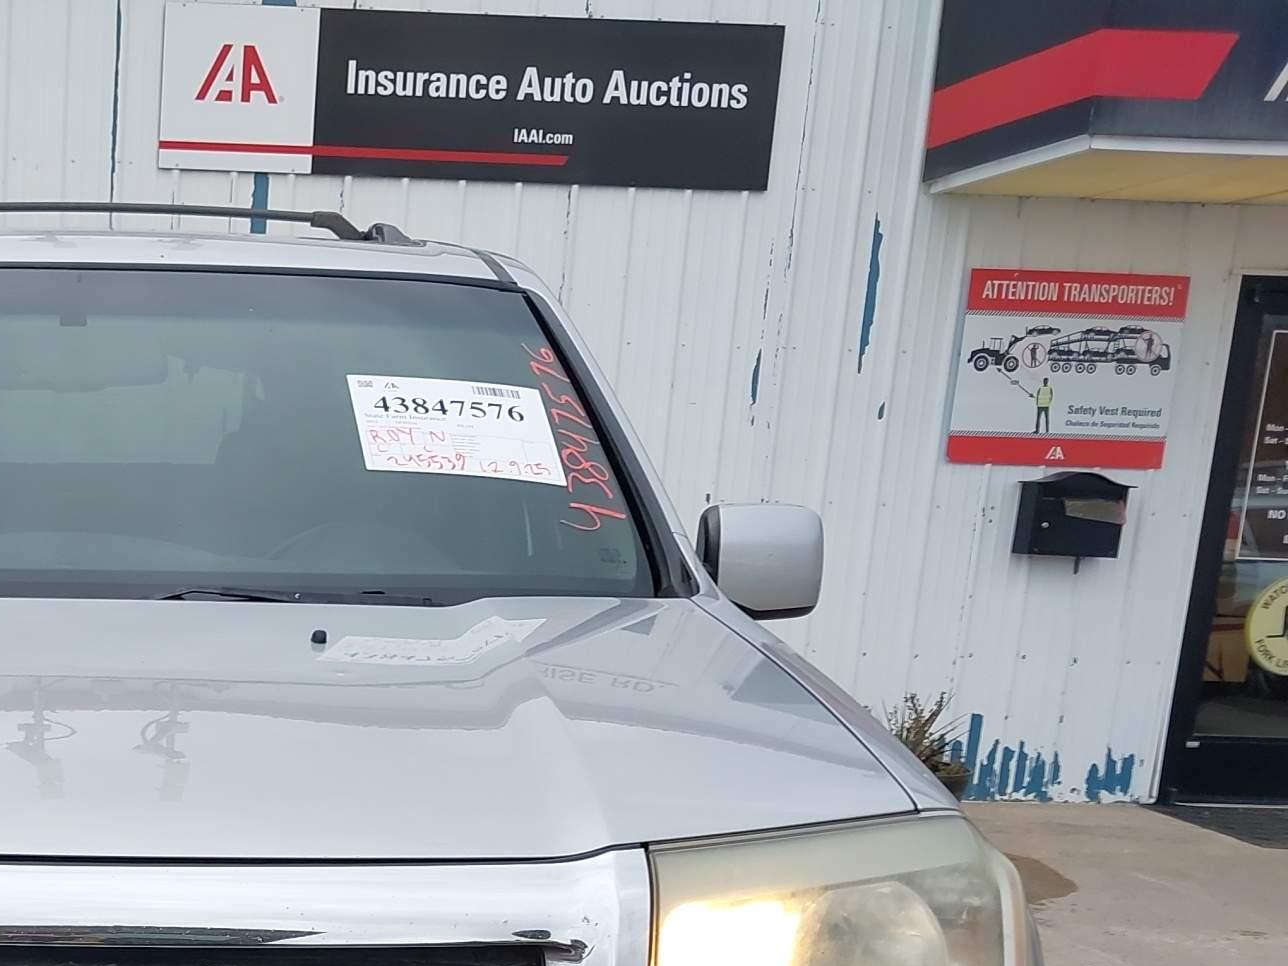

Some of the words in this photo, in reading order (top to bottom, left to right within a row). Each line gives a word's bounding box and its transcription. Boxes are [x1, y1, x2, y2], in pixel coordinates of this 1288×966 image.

[346, 58, 507, 100] Insurance
[516, 66, 594, 103] Auto
[602, 69, 749, 110] Auctions
[512, 127, 574, 146] IAAI.com
[982, 279, 1059, 301] ATTENTION
[1063, 283, 1175, 306] TRANSPORTERS!
[373, 395, 525, 423] 43847576
[1067, 404, 1097, 417] Safety
[1098, 405, 1119, 417] Vest
[1120, 406, 1162, 419] Required
[1267, 510, 1287, 520] NO
